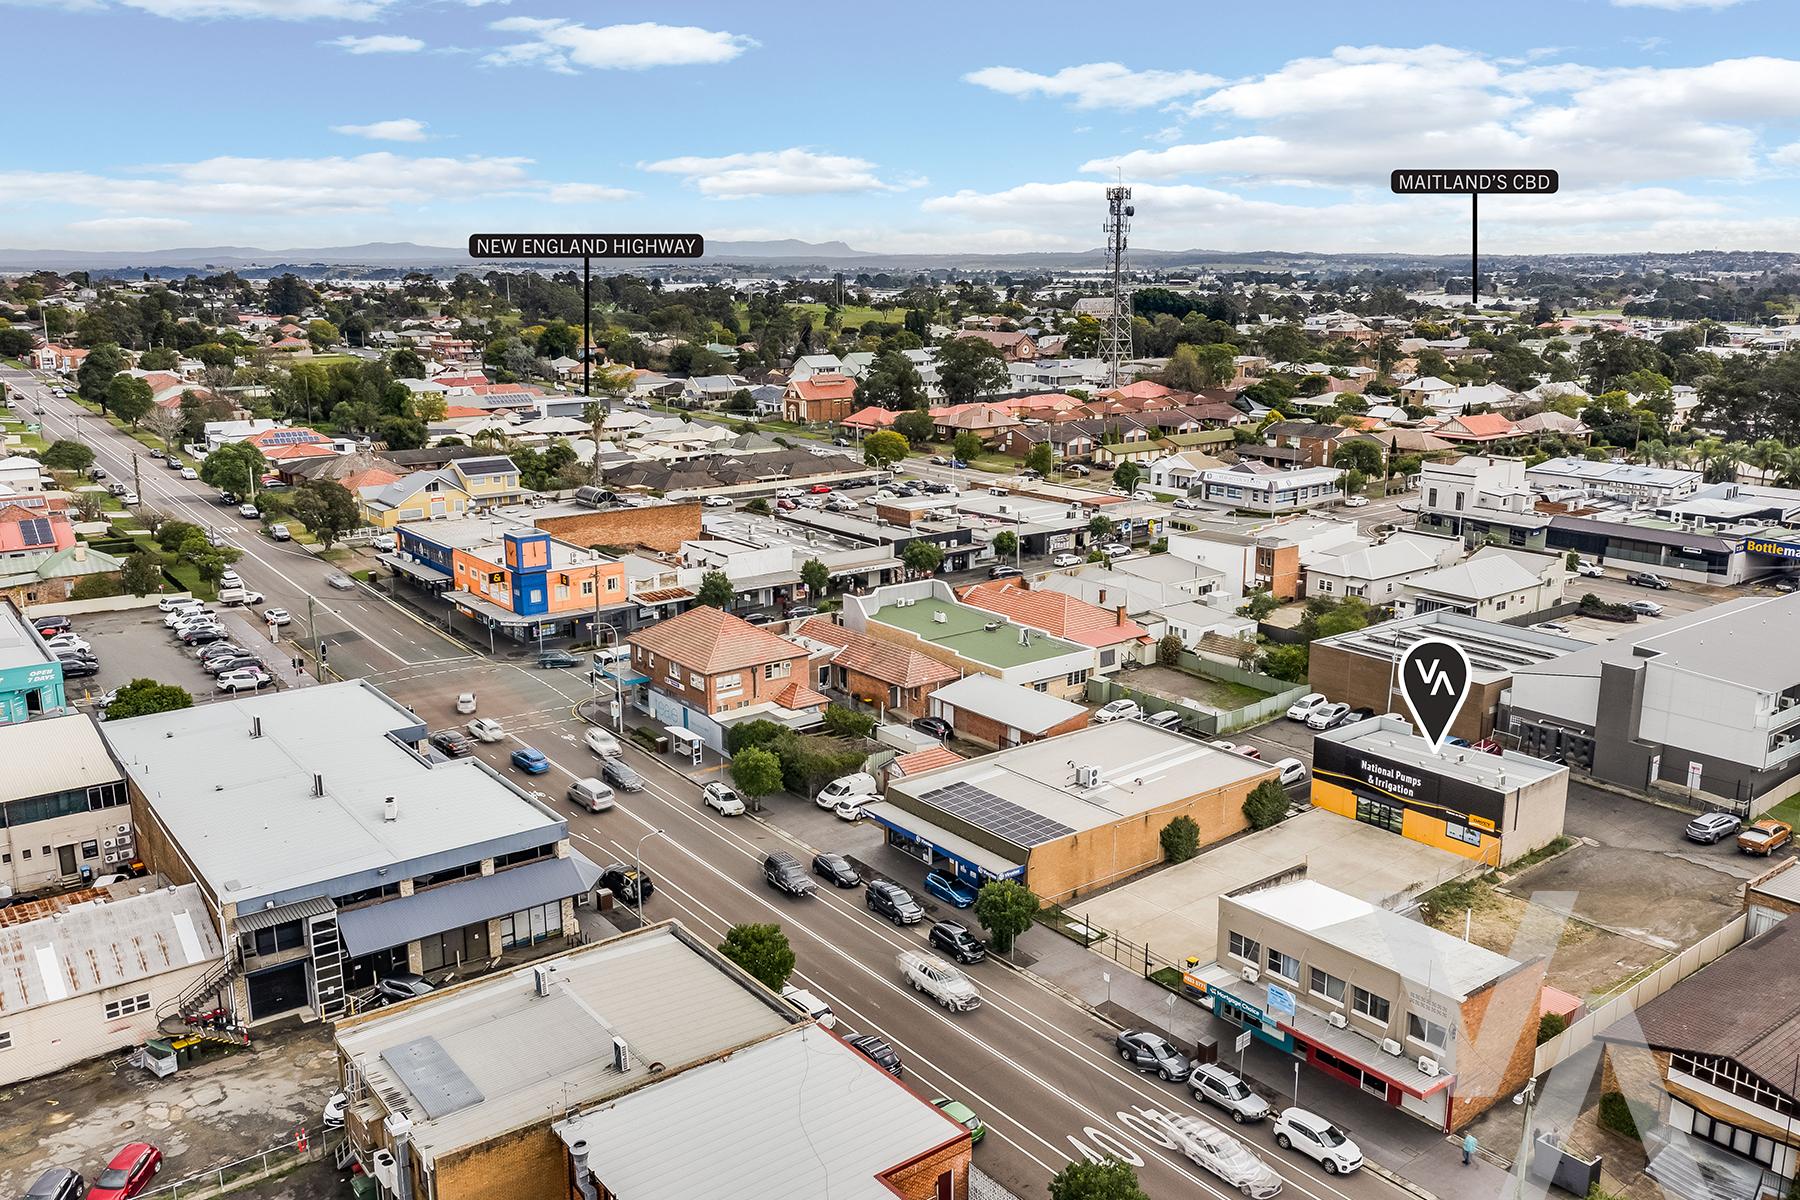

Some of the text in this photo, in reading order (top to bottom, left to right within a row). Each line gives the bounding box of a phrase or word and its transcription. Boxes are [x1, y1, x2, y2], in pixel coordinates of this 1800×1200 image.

[493, 573, 501, 582] &
[30, 669, 53, 677] OPEN
[34, 674, 55, 682] DAYS
[1361, 760, 1422, 787] National Pumps
[1368, 774, 1414, 797] & Irrigation
[1217, 990, 1260, 1015] Mortgage Choice
